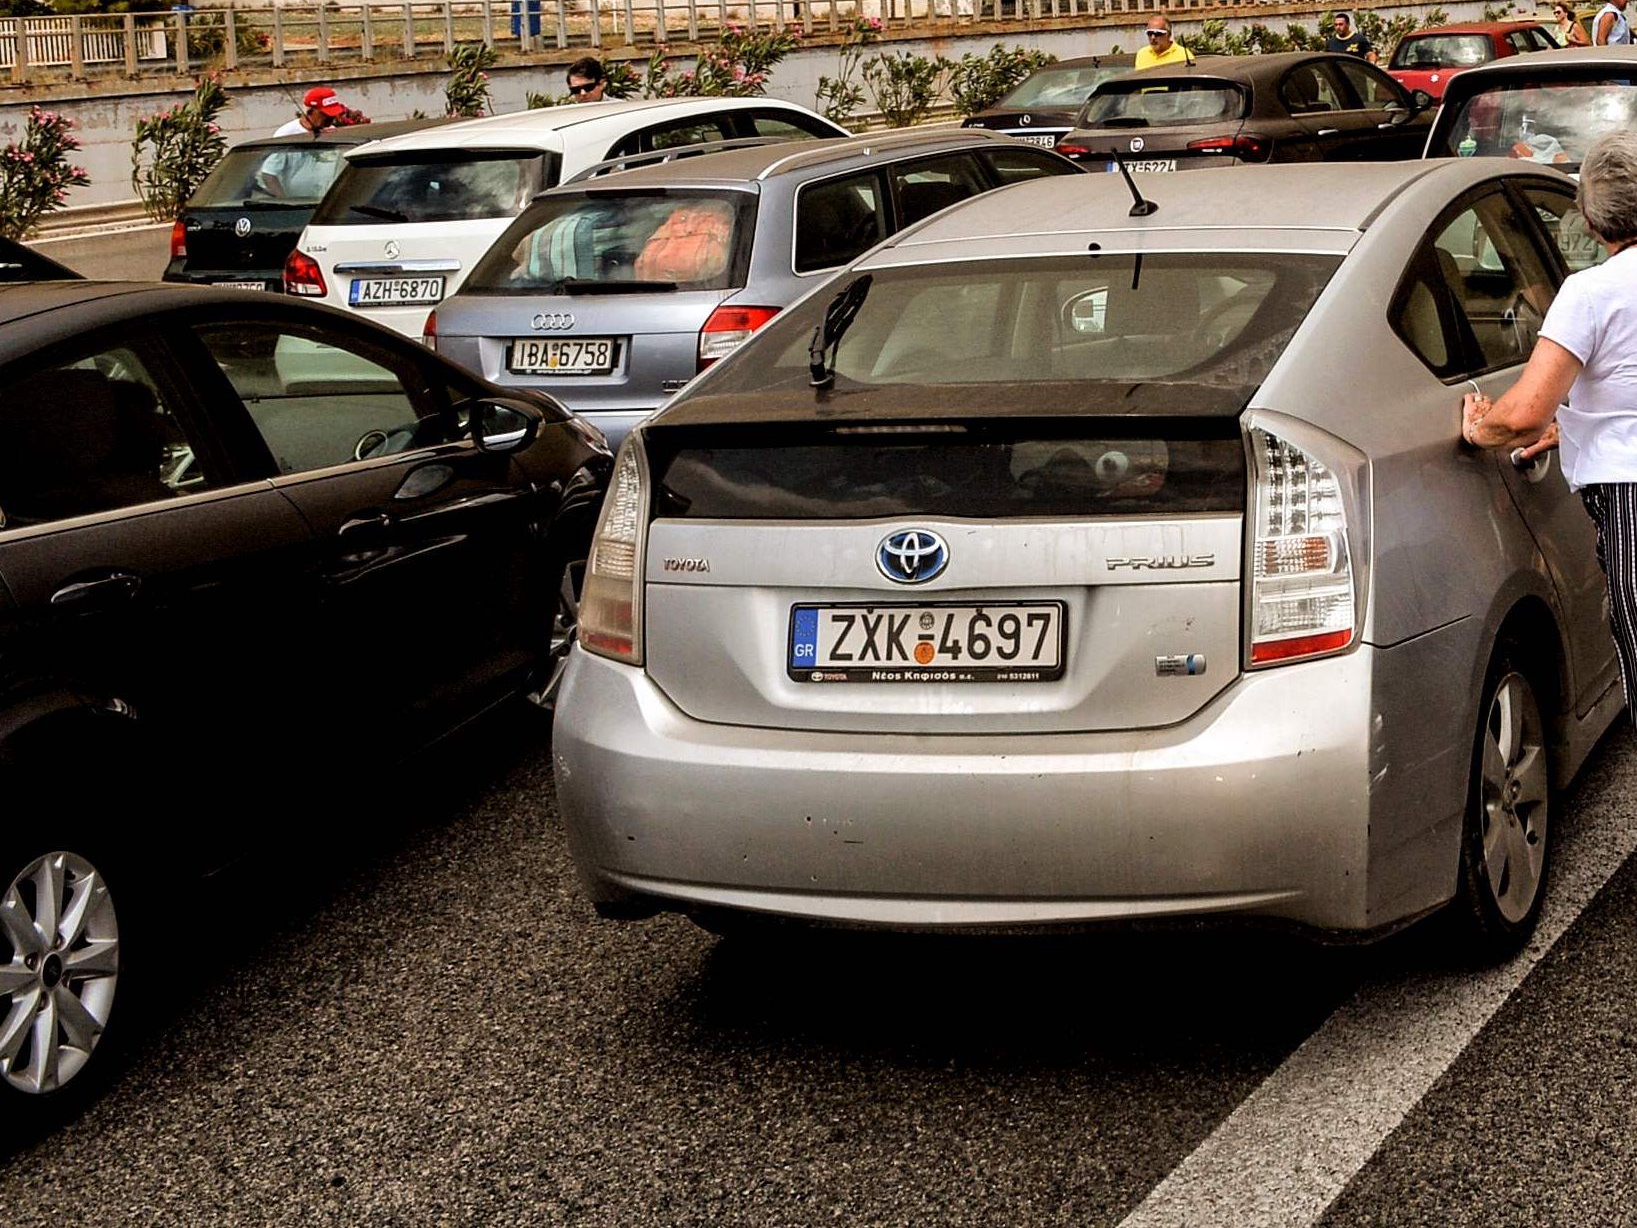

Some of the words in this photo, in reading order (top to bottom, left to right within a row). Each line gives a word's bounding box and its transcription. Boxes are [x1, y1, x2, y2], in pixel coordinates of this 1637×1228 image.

[362, 280, 439, 300] AZH-6870
[663, 557, 711, 573] TOYOTA
[1105, 553, 1216, 571] PRIUS
[829, 613, 1051, 661] ZXK-4697
[794, 643, 814, 657] GR
[872, 671, 901, 680] Νέος
[904, 671, 956, 681] Κηφισός
